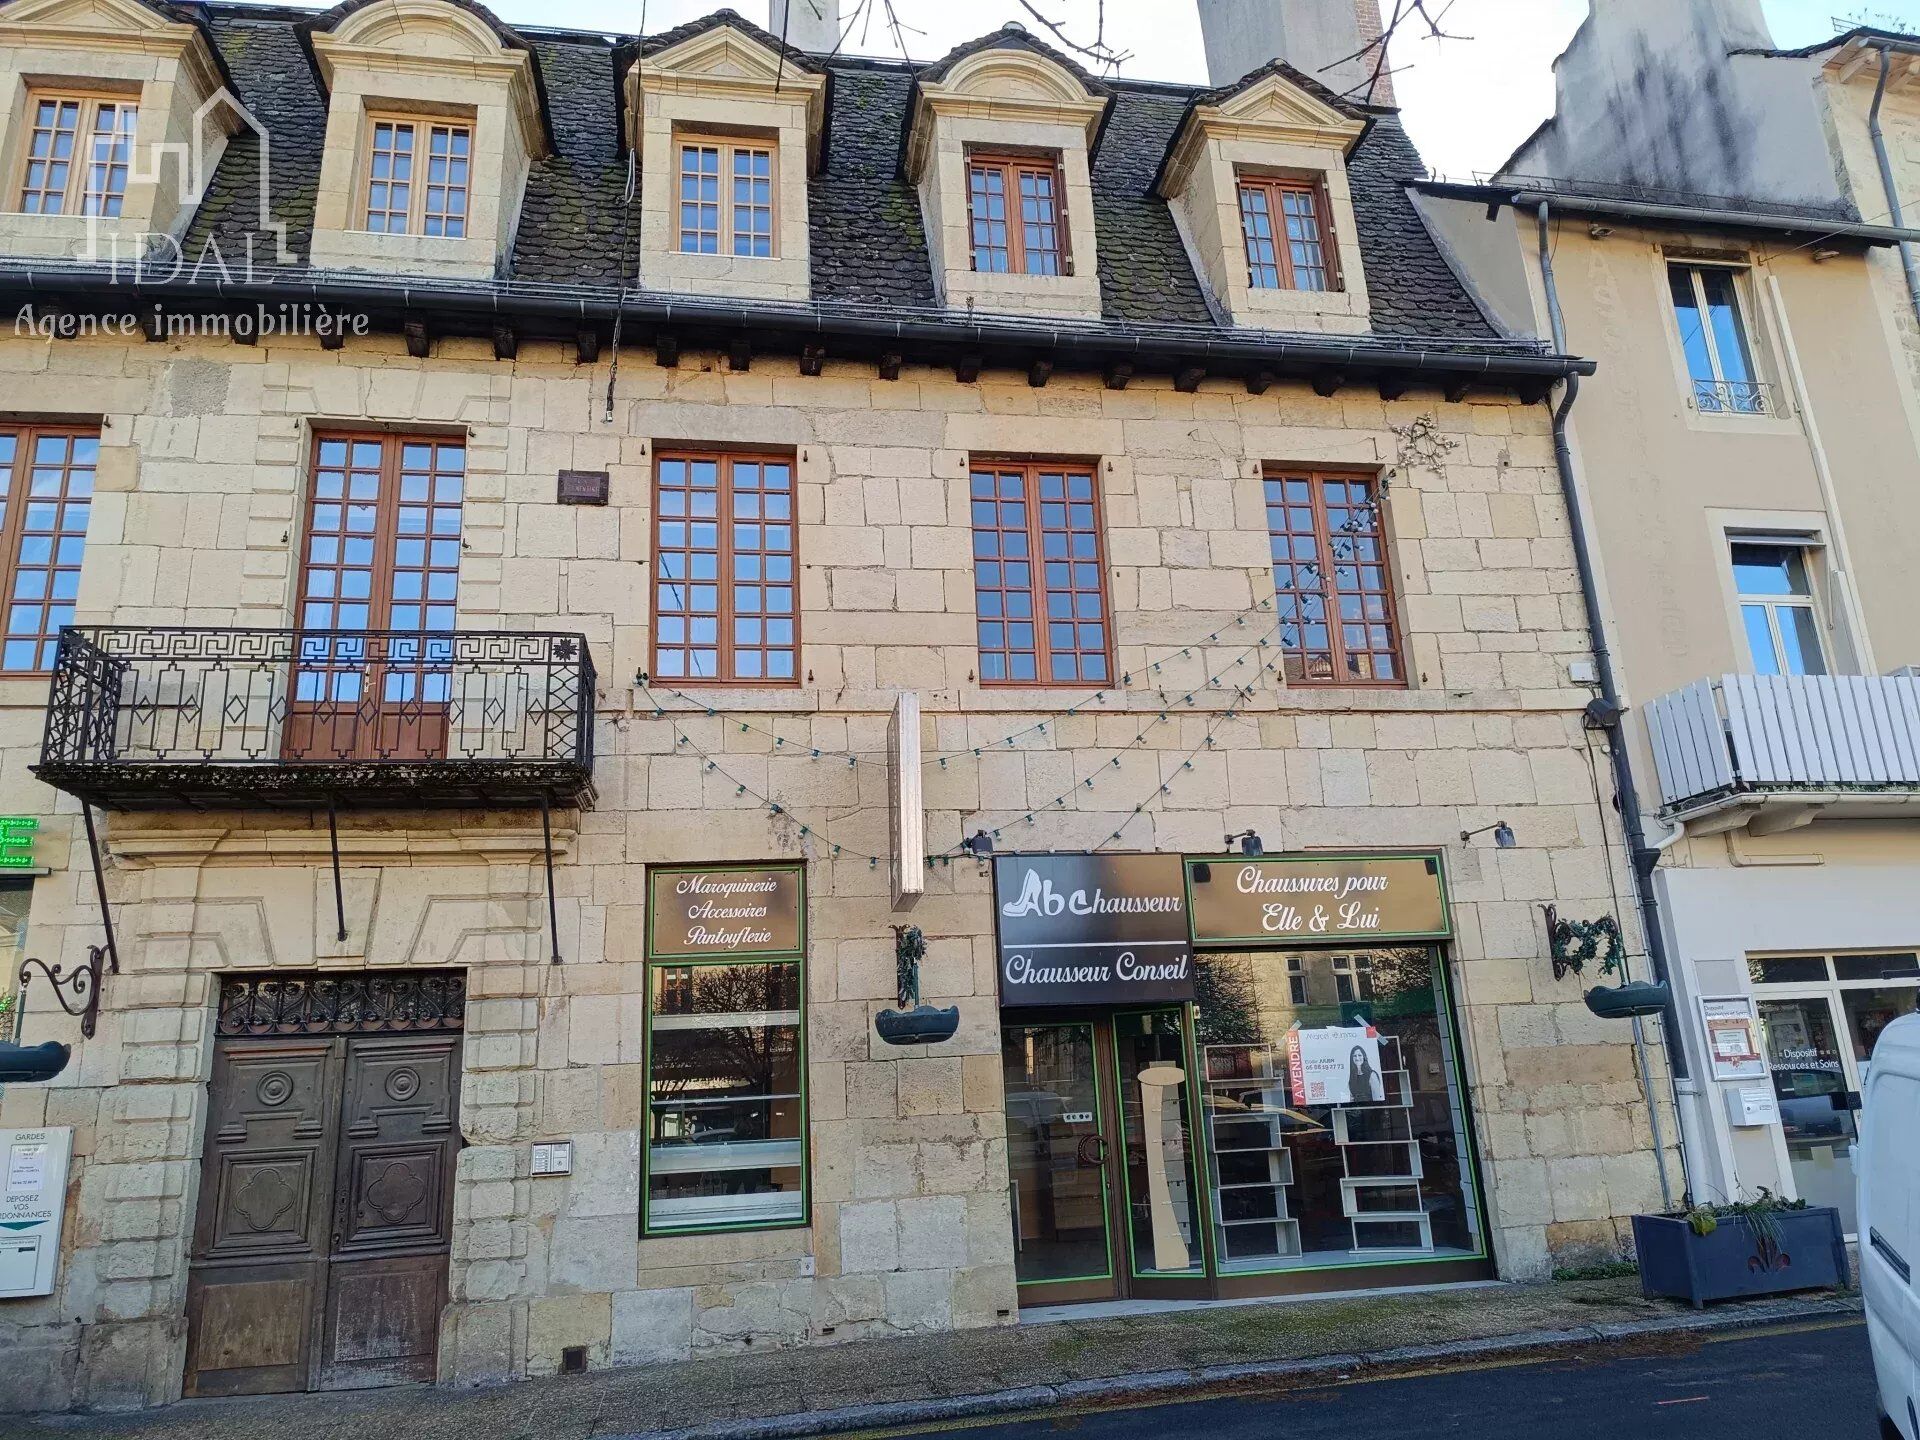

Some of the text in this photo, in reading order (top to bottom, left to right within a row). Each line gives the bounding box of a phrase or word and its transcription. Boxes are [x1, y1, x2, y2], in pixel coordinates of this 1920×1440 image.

[676, 874, 777, 898] Maroquinerie
[1236, 865, 1388, 900] Chaussures pour
[688, 900, 767, 919] Accessoires
[1262, 901, 1380, 932] Elle & Lui
[683, 925, 771, 949] Pantouflerie
[1005, 951, 1188, 984] Chausseur Conseil
[1288, 1036, 1303, 1087] VENDRE
[1783, 1047, 1818, 1060] Dispositif
[1768, 1061, 1810, 1071] Ressources
[1819, 1059, 1840, 1069] Soins
[15, 1132, 46, 1141] GARDES
[6, 1194, 40, 1203] DEPOSEZ
[13, 1203, 30, 1211] VOS
